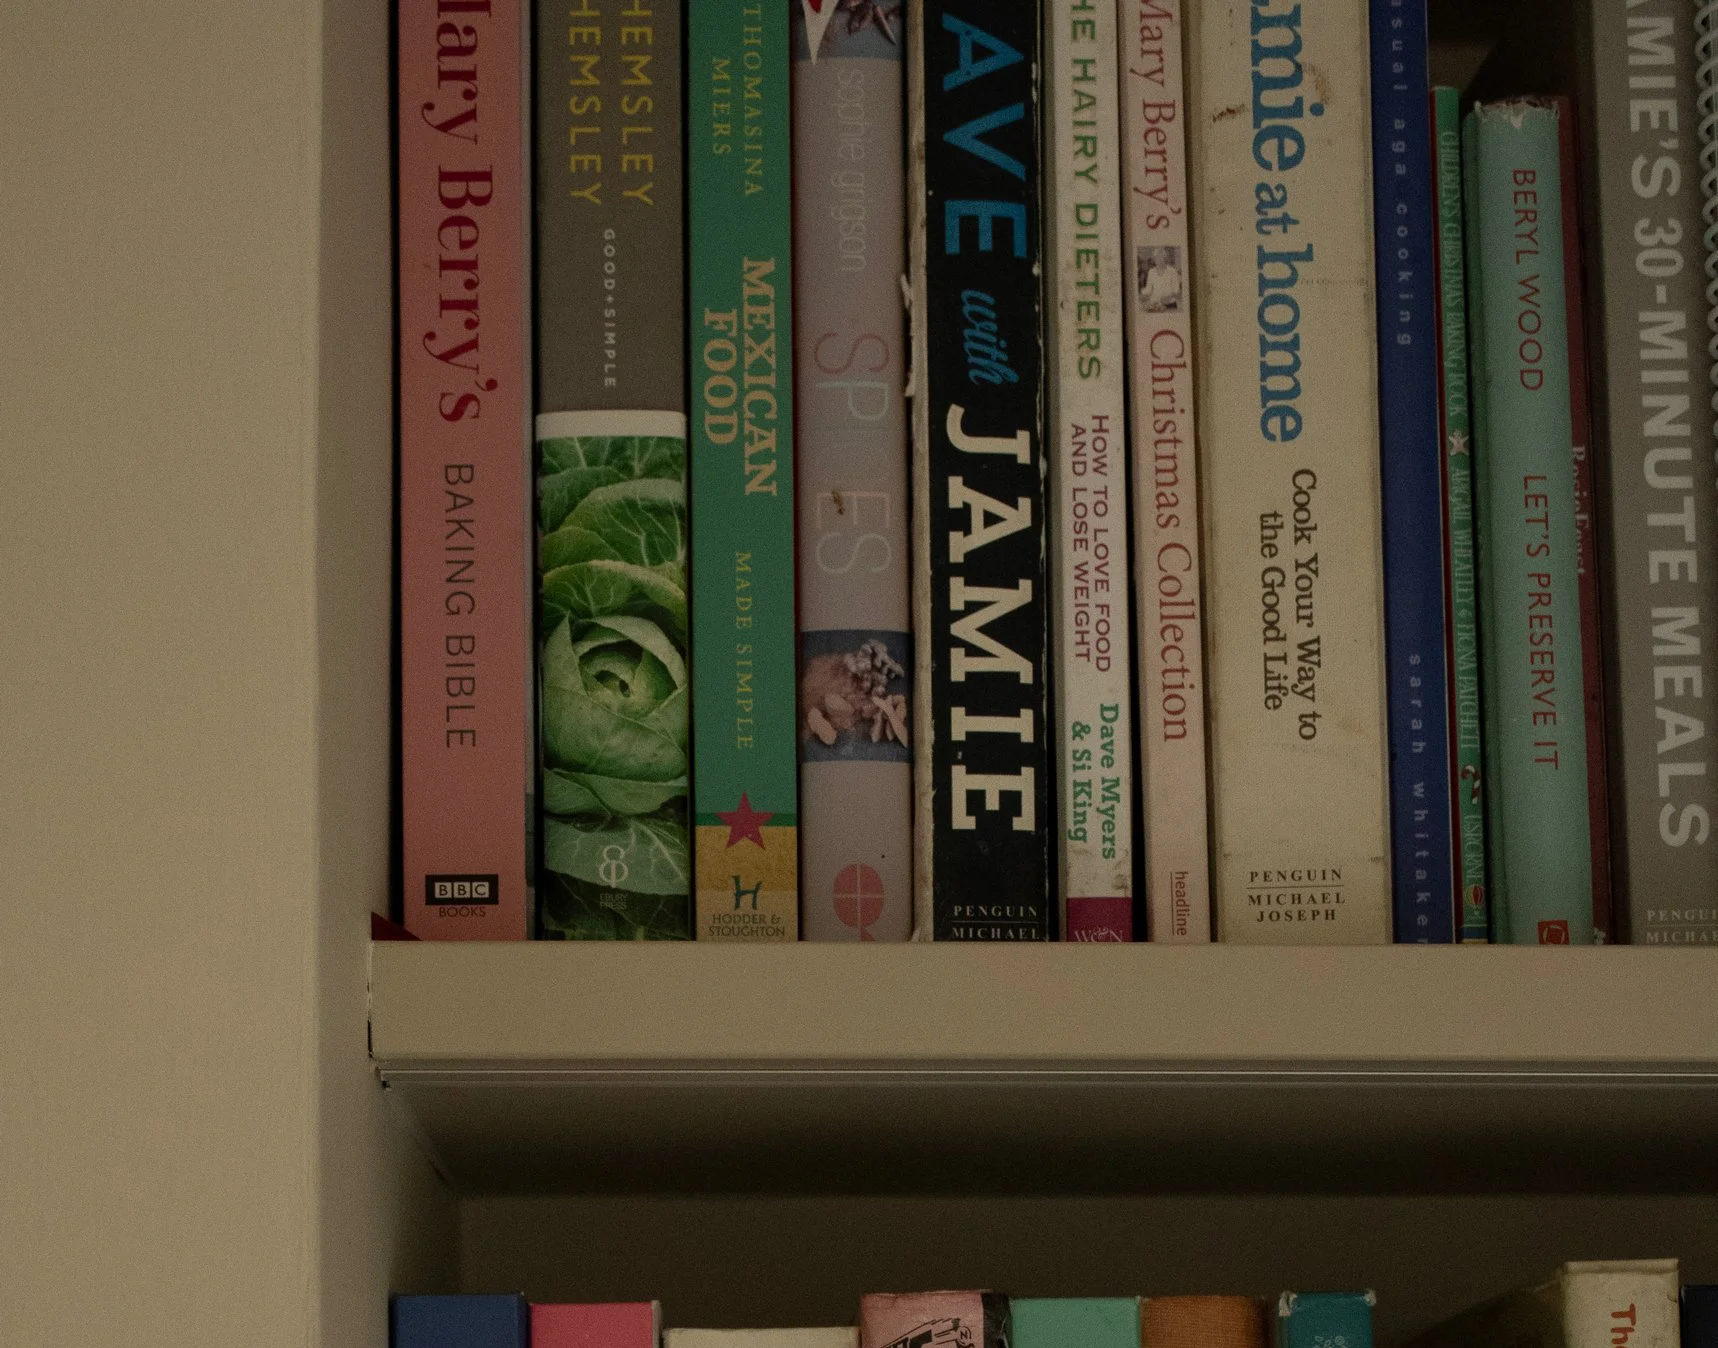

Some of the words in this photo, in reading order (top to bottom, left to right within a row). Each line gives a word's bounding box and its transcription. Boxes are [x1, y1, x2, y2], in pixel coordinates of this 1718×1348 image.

[421, 0, 491, 145] ary
[570, 0, 603, 206] HEMSLEY
[621, 0, 654, 206] HEMSLEY
[712, 57, 732, 155] MIERS
[743, 5, 763, 197] THOMASINA
[837, 70, 878, 162] sophie
[1249, 0, 1324, 172] mie
[1627, 0, 1682, 198] MIE'S
[942, 11, 1026, 259] AVE
[1072, 58, 1098, 184] HAIRY
[1391, 120, 1407, 176] aga
[1133, 100, 1181, 230] Berry's
[832, 171, 869, 273] grigson
[1255, 183, 1299, 235] at
[1513, 169, 1538, 264] BERYL
[423, 165, 497, 422] Berry's
[1075, 203, 1101, 380] DIETERS
[1396, 204, 1413, 345] cooking
[704, 308, 738, 445] FOOD
[743, 257, 777, 496] MEXICAN
[961, 288, 1019, 385] with
[1257, 244, 1314, 443] home
[1518, 275, 1544, 391] WOOD
[1149, 329, 1187, 528] Christmas
[1634, 218, 1696, 584] 30-MINUTE
[1071, 424, 1087, 477] AND
[1092, 415, 1108, 477] HOW
[444, 464, 475, 616] BAKING
[1073, 487, 1089, 552] LOSE
[1093, 483, 1109, 517] TO
[1261, 510, 1278, 558] the
[1293, 470, 1317, 544] Cook
[1523, 475, 1551, 557] LET'S
[736, 552, 752, 630] MADE
[1094, 528, 1110, 592] LOVE
[1294, 553, 1320, 628] Your
[946, 404, 1035, 831] JAMIE
[1074, 560, 1091, 661] WEIGHT
[1095, 604, 1111, 672] FOOD
[1157, 542, 1196, 742] Collection
[1261, 566, 1287, 644] Good
[445, 635, 476, 749] BIBLE
[1263, 652, 1288, 710] Life
[1292, 637, 1321, 704] Way
[1527, 573, 1556, 727] PRESERVE
[737, 645, 754, 749] SIMPLE
[1072, 722, 1092, 740] &
[1100, 704, 1119, 768] Dave
[1298, 714, 1321, 741] to
[1409, 654, 1426, 753] sarah
[1651, 608, 1710, 847] MEALS
[1073, 749, 1091, 772] Si
[1534, 742, 1559, 769] IT
[1068, 779, 1093, 842] King
[1100, 777, 1120, 859] Myers
[439, 885, 486, 896] BBC
[1175, 871, 1189, 936] headline
[1248, 892, 1345, 906] MICHAEL
[1250, 869, 1342, 882] PENGUIN
[1413, 782, 1430, 943] whitaker
[439, 907, 486, 917] BOOKS
[708, 926, 785, 936] STOUGHTON
[713, 914, 767, 924] HODDER
[771, 914, 780, 924] &
[952, 928, 1038, 939] MICHAEL
[954, 905, 1037, 917] PENGUIN
[1257, 908, 1336, 922] JOSEPH
